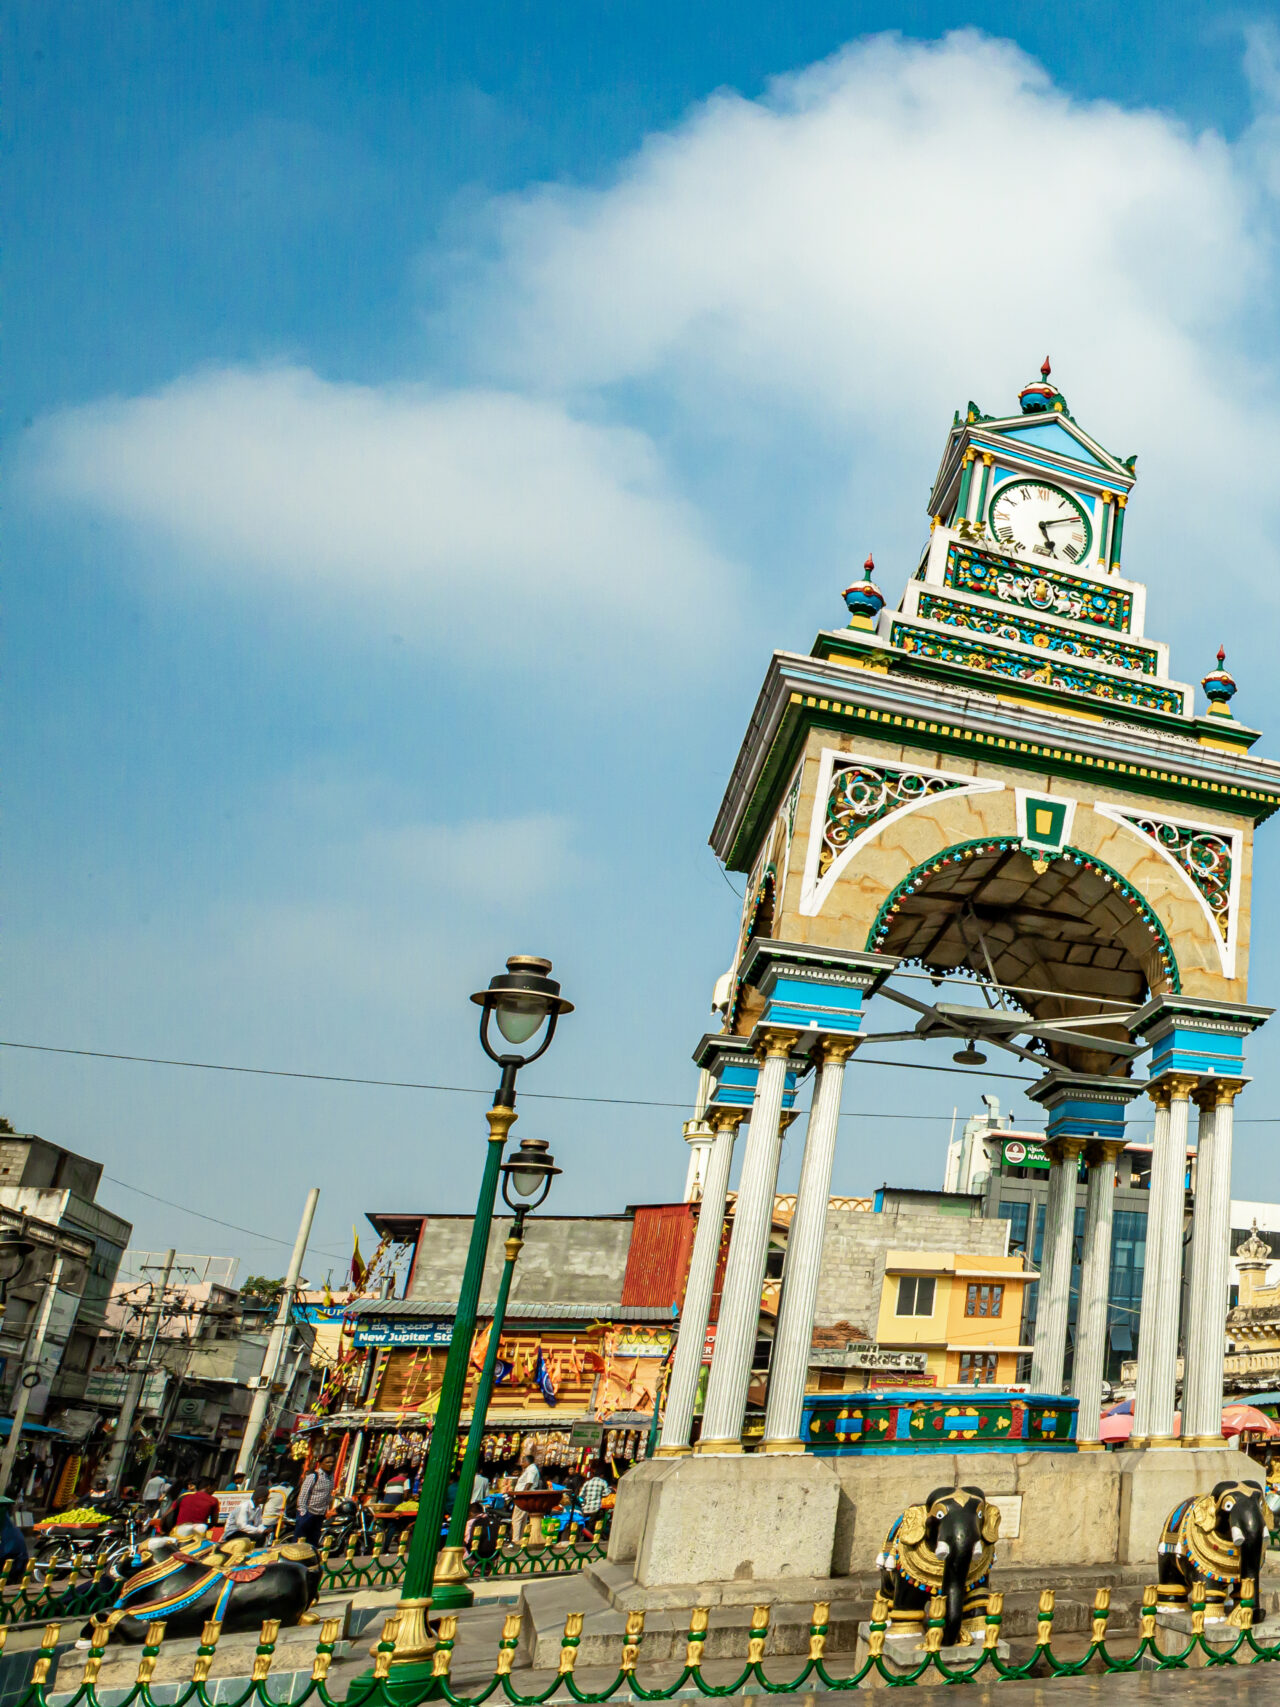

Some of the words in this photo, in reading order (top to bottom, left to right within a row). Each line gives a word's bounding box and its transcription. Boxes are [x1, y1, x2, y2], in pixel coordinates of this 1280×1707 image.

[359, 1332, 386, 1342] New
[388, 1332, 431, 1343] Jupiter
[433, 1332, 453, 1342] Sto
